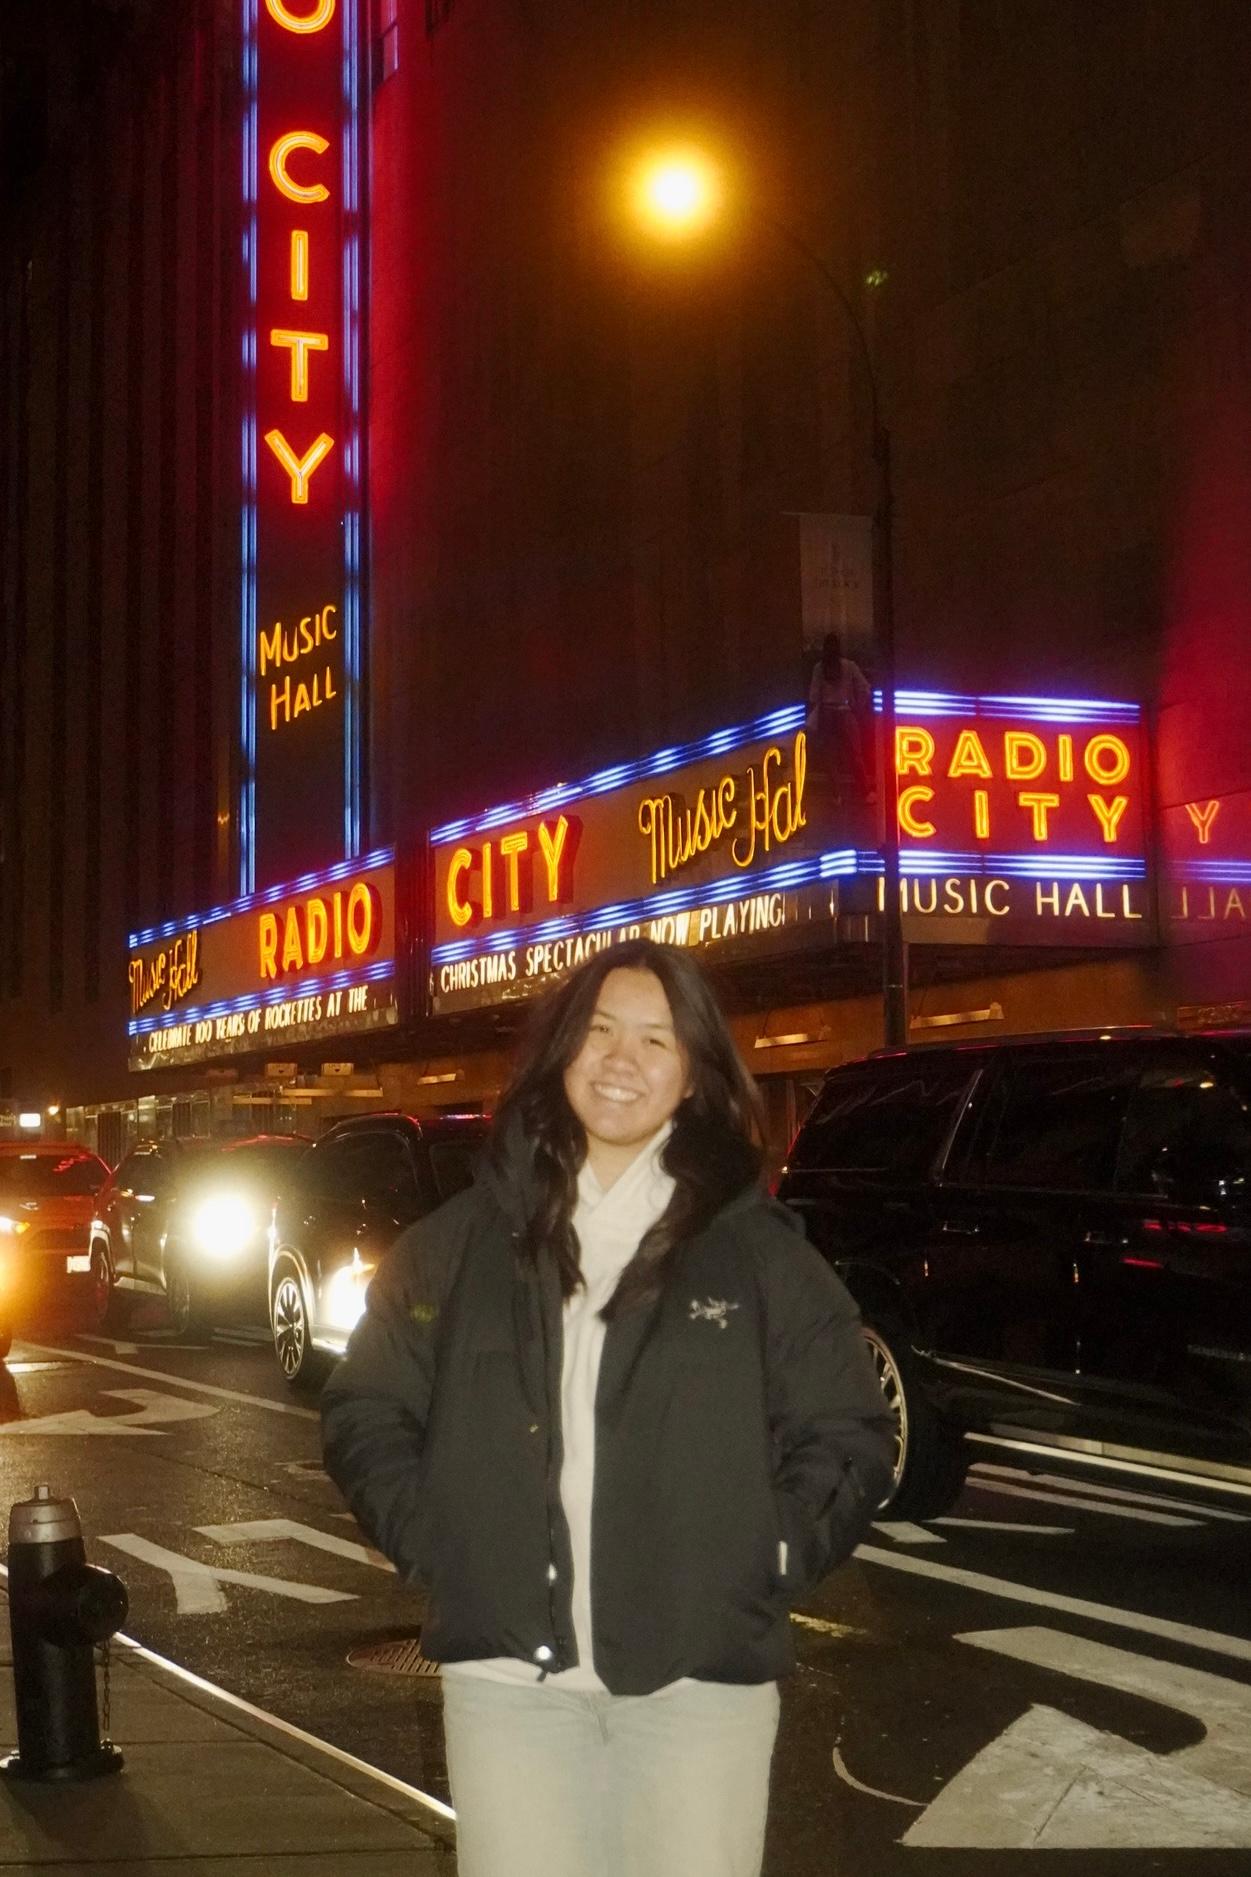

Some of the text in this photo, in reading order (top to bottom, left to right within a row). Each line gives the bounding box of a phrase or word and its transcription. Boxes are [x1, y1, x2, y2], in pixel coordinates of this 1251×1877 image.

[264, 130, 336, 504] CITY
[260, 605, 337, 676] MUSIC
[271, 666, 337, 730] HALL
[895, 726, 1130, 785] RADIO
[638, 730, 807, 885] Music Hal
[898, 785, 1129, 843] CITY
[447, 814, 569, 926] CITY
[1036, 881, 1142, 919] HALL
[258, 882, 372, 979] RADIO
[440, 950, 517, 993] CHRISTMAS
[650, 911, 692, 947] NOW
[194, 1019, 213, 1045] 100
[216, 1013, 245, 1040] YEARS
[246, 1008, 262, 1035] OF
[264, 995, 323, 1031] ROCKETTES
[326, 991, 343, 1018] AT
[348, 984, 369, 1014] THE
